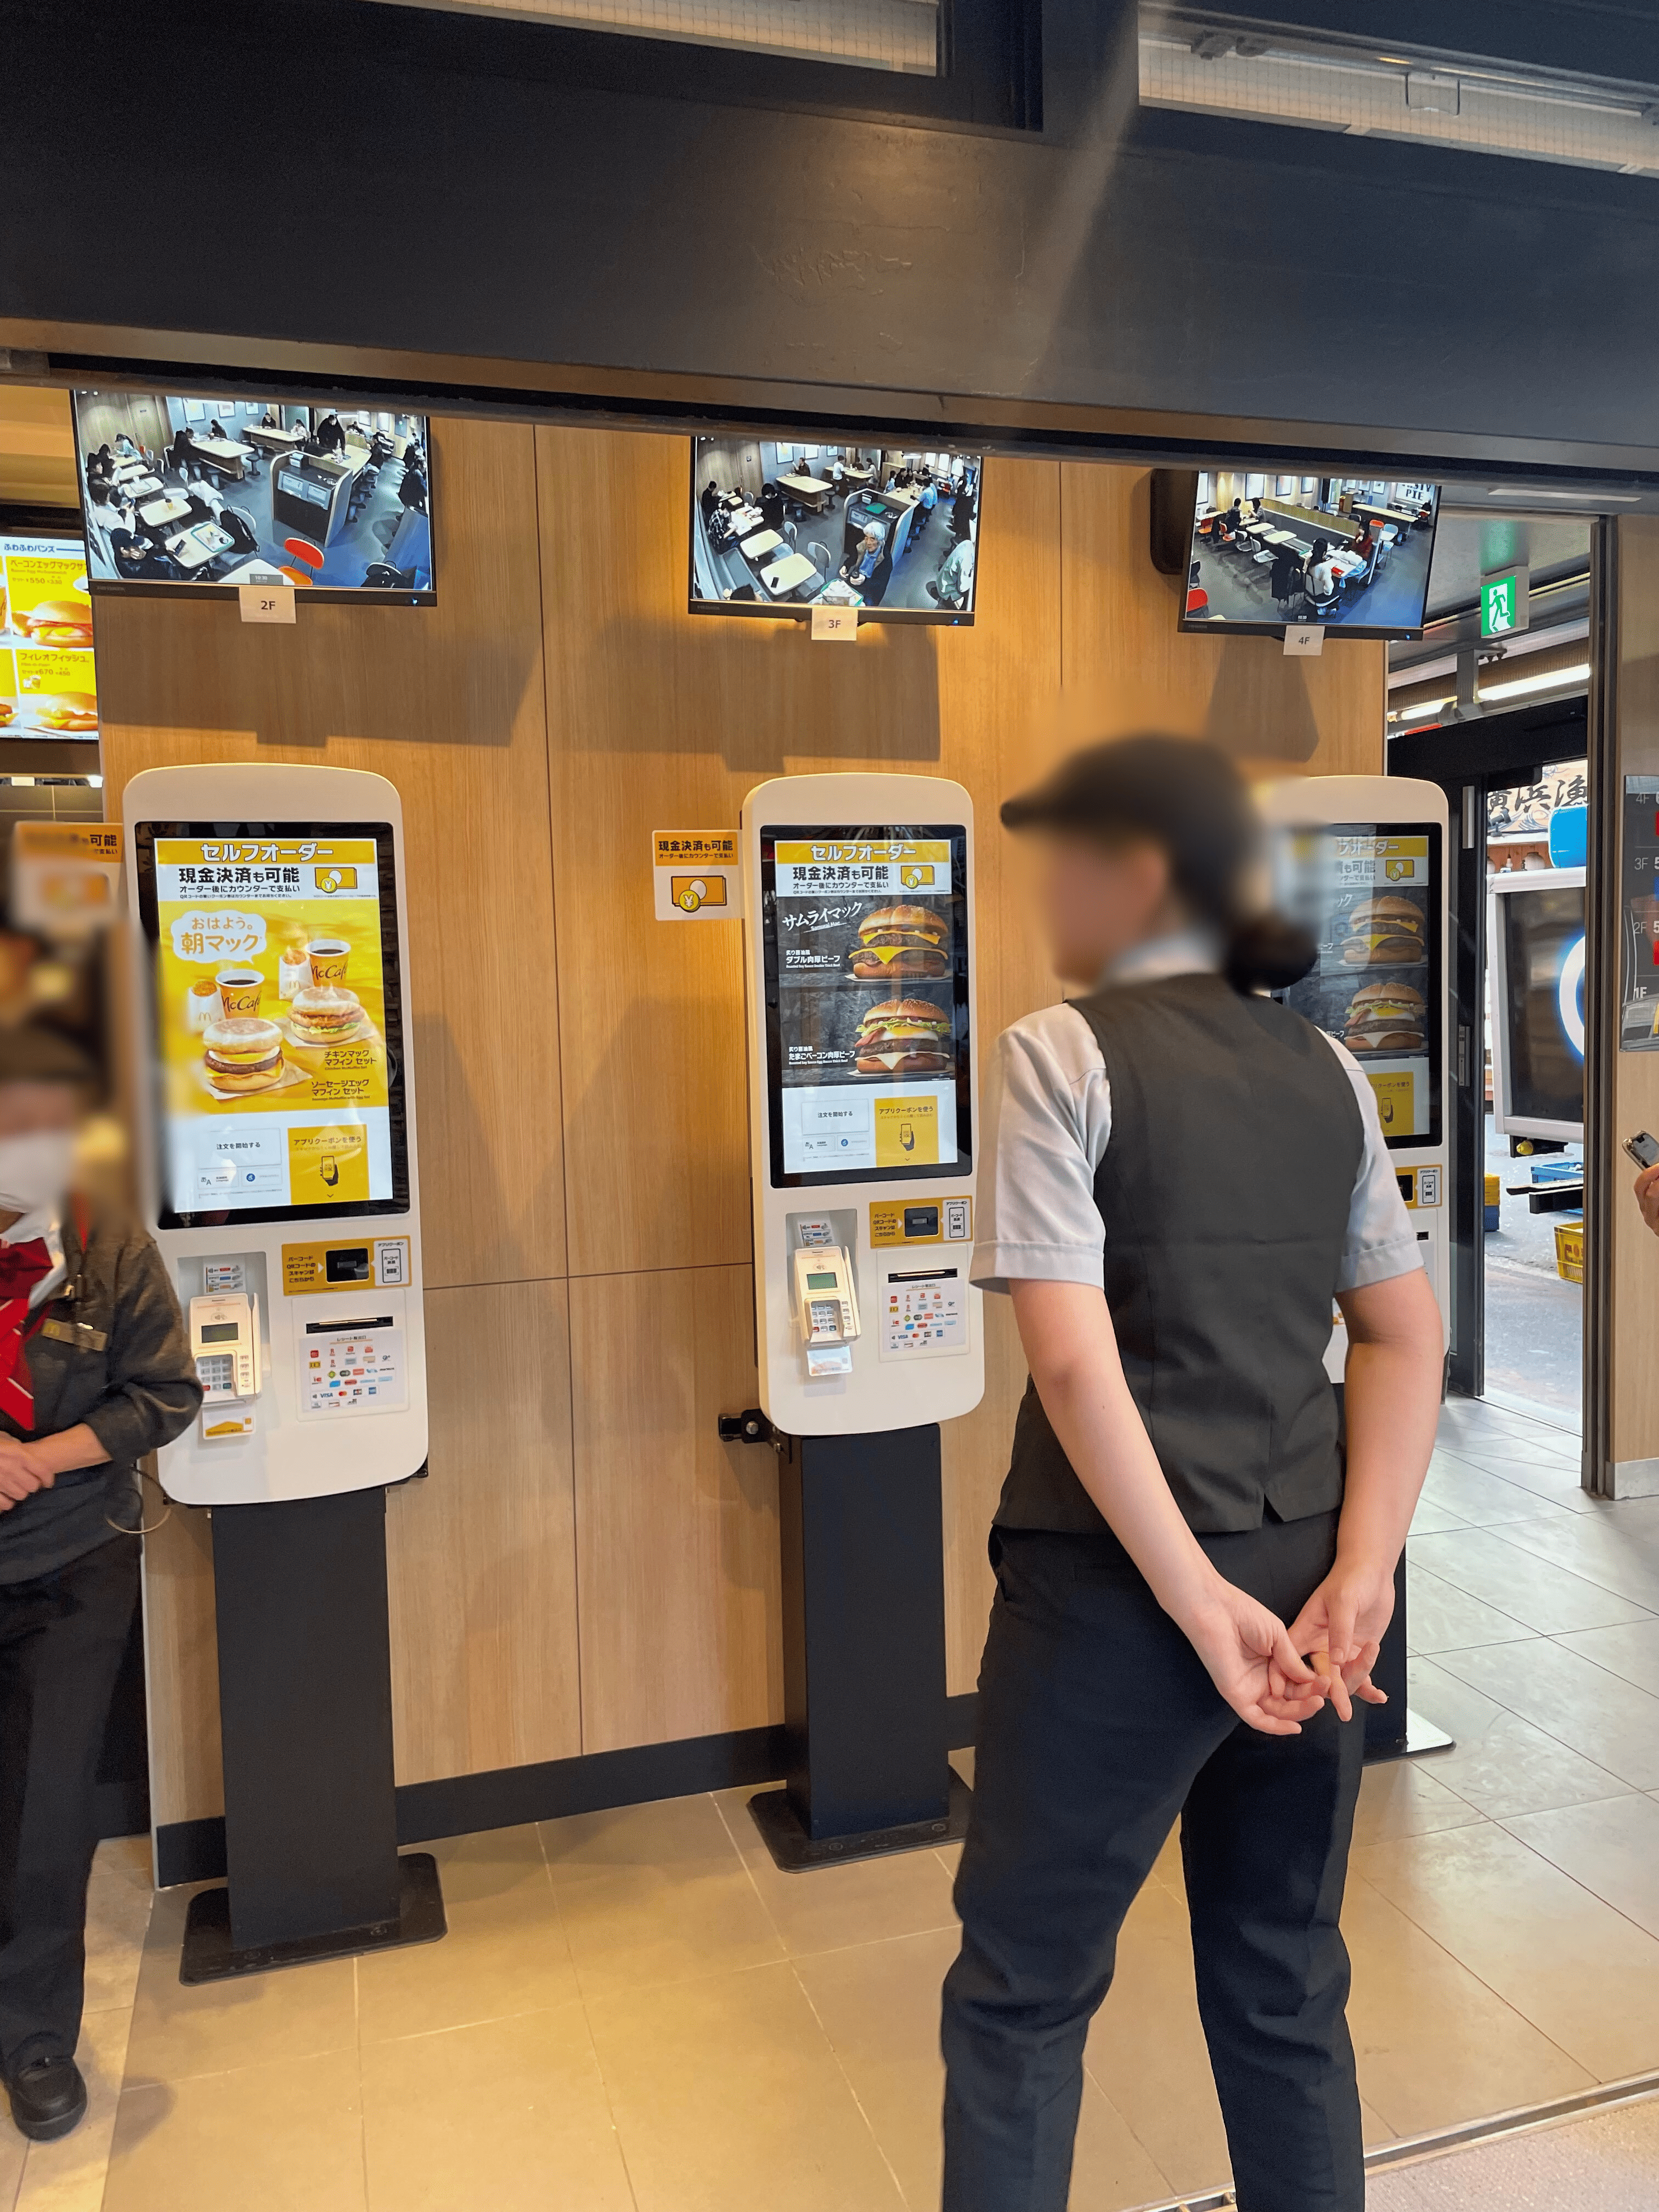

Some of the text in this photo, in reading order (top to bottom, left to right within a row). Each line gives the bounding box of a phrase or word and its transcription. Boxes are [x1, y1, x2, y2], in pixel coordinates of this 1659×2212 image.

[1406, 489, 1424, 501] PIE
[4, 544, 55, 553] ふわふわバンズ
[10, 560, 87, 571] ベーコンエッグマックサ
[261, 601, 275, 611] 2F
[828, 620, 841, 629] 3F
[1298, 636, 1310, 645] 4F
[20, 652, 87, 663] フィレオフィッシュ
[1635, 793, 1650, 804] 4F
[658, 840, 733, 851] 現金決済も可能
[1338, 839, 1399, 856] フオーダー
[201, 843, 334, 862] セルフオーダー
[811, 843, 916, 861] セルフオーダー
[1634, 857, 1649, 870] 3F
[179, 867, 300, 883] 現金決済も可能
[793, 866, 889, 881] 現金決済も可能
[180, 885, 300, 893] オーダー後にカウンターで支払い
[782, 901, 862, 932] サムライマック
[191, 917, 253, 930] おはよう。
[1634, 922, 1647, 934] 2F
[180, 932, 259, 955] 朝マック
[1634, 986, 1647, 998] 1F
[325, 1049, 369, 1058] チキンマック
[312, 1079, 369, 1088] ソーセージエッグ
[879, 1106, 933, 1114] アプリクーポンを使う
[217, 1142, 261, 1150] 注文を開始する
[294, 1136, 362, 1146] アプリクーポンを使う
